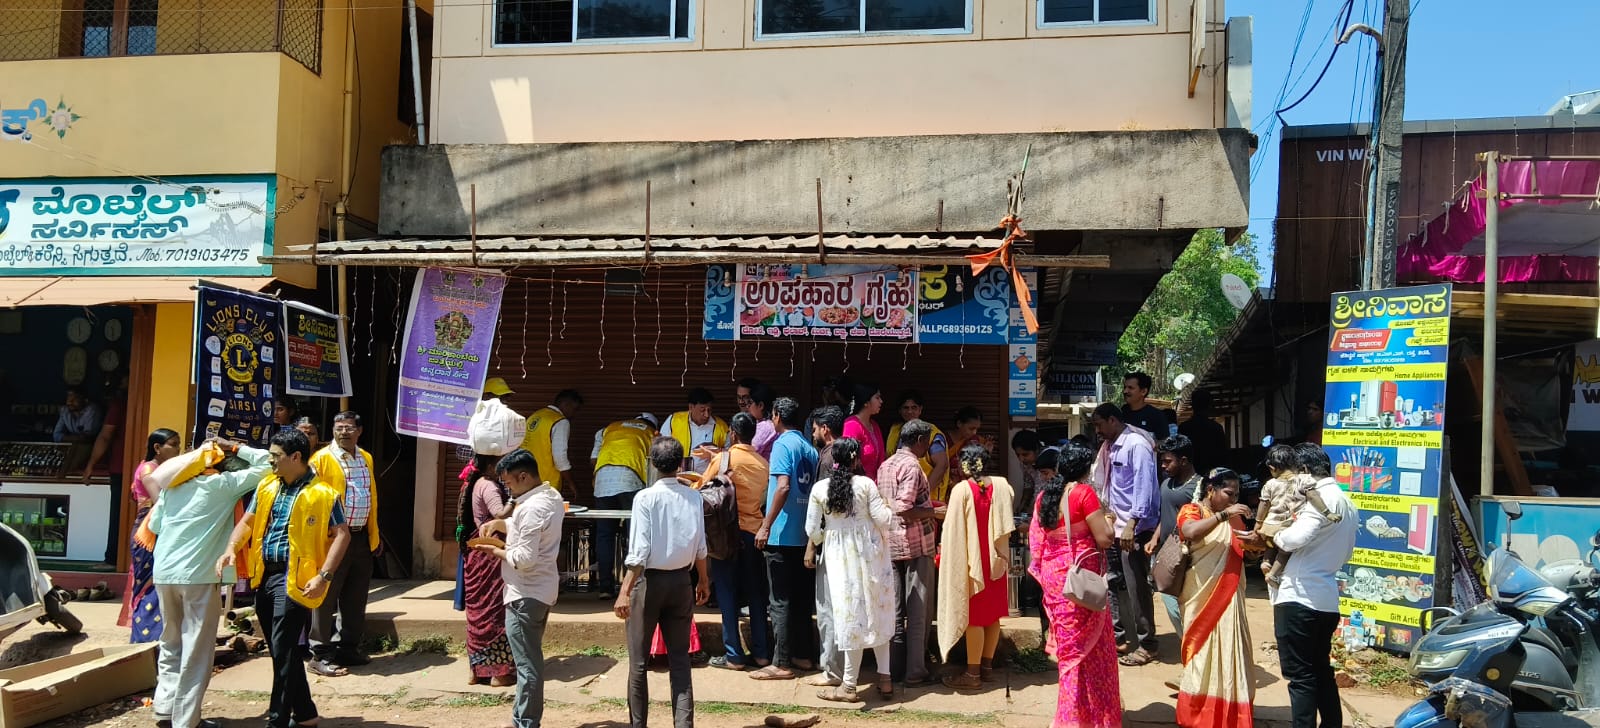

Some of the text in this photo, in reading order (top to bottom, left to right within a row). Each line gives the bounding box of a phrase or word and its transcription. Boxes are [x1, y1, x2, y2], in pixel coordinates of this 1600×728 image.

[1316, 149, 1344, 162] VIN
[32, 185, 207, 223] ಮೊಬೈಲ್
[165, 248, 250, 262] 7019103475
[746, 268, 911, 321] ಉಪಹಾರ ಗೃಹ
[1331, 286, 1447, 329] ಶ್ರೀನಿವಾಸ
[206, 304, 275, 343] LIONS CLUB
[918, 323, 993, 335] ALLPG8936D1ZS
[235, 349, 247, 368] L
[1394, 371, 1444, 380] Home Appliances
[229, 399, 257, 412] SIRSI
[1353, 437, 1379, 446] Electrical
[1391, 439, 1423, 447] Electronics
[1423, 440, 1440, 448] Items
[1360, 501, 1389, 510] Furnitures
[1349, 556, 1421, 570] teel, Brass, Copper Utensils
[1390, 612, 1421, 625] Gift Artic
